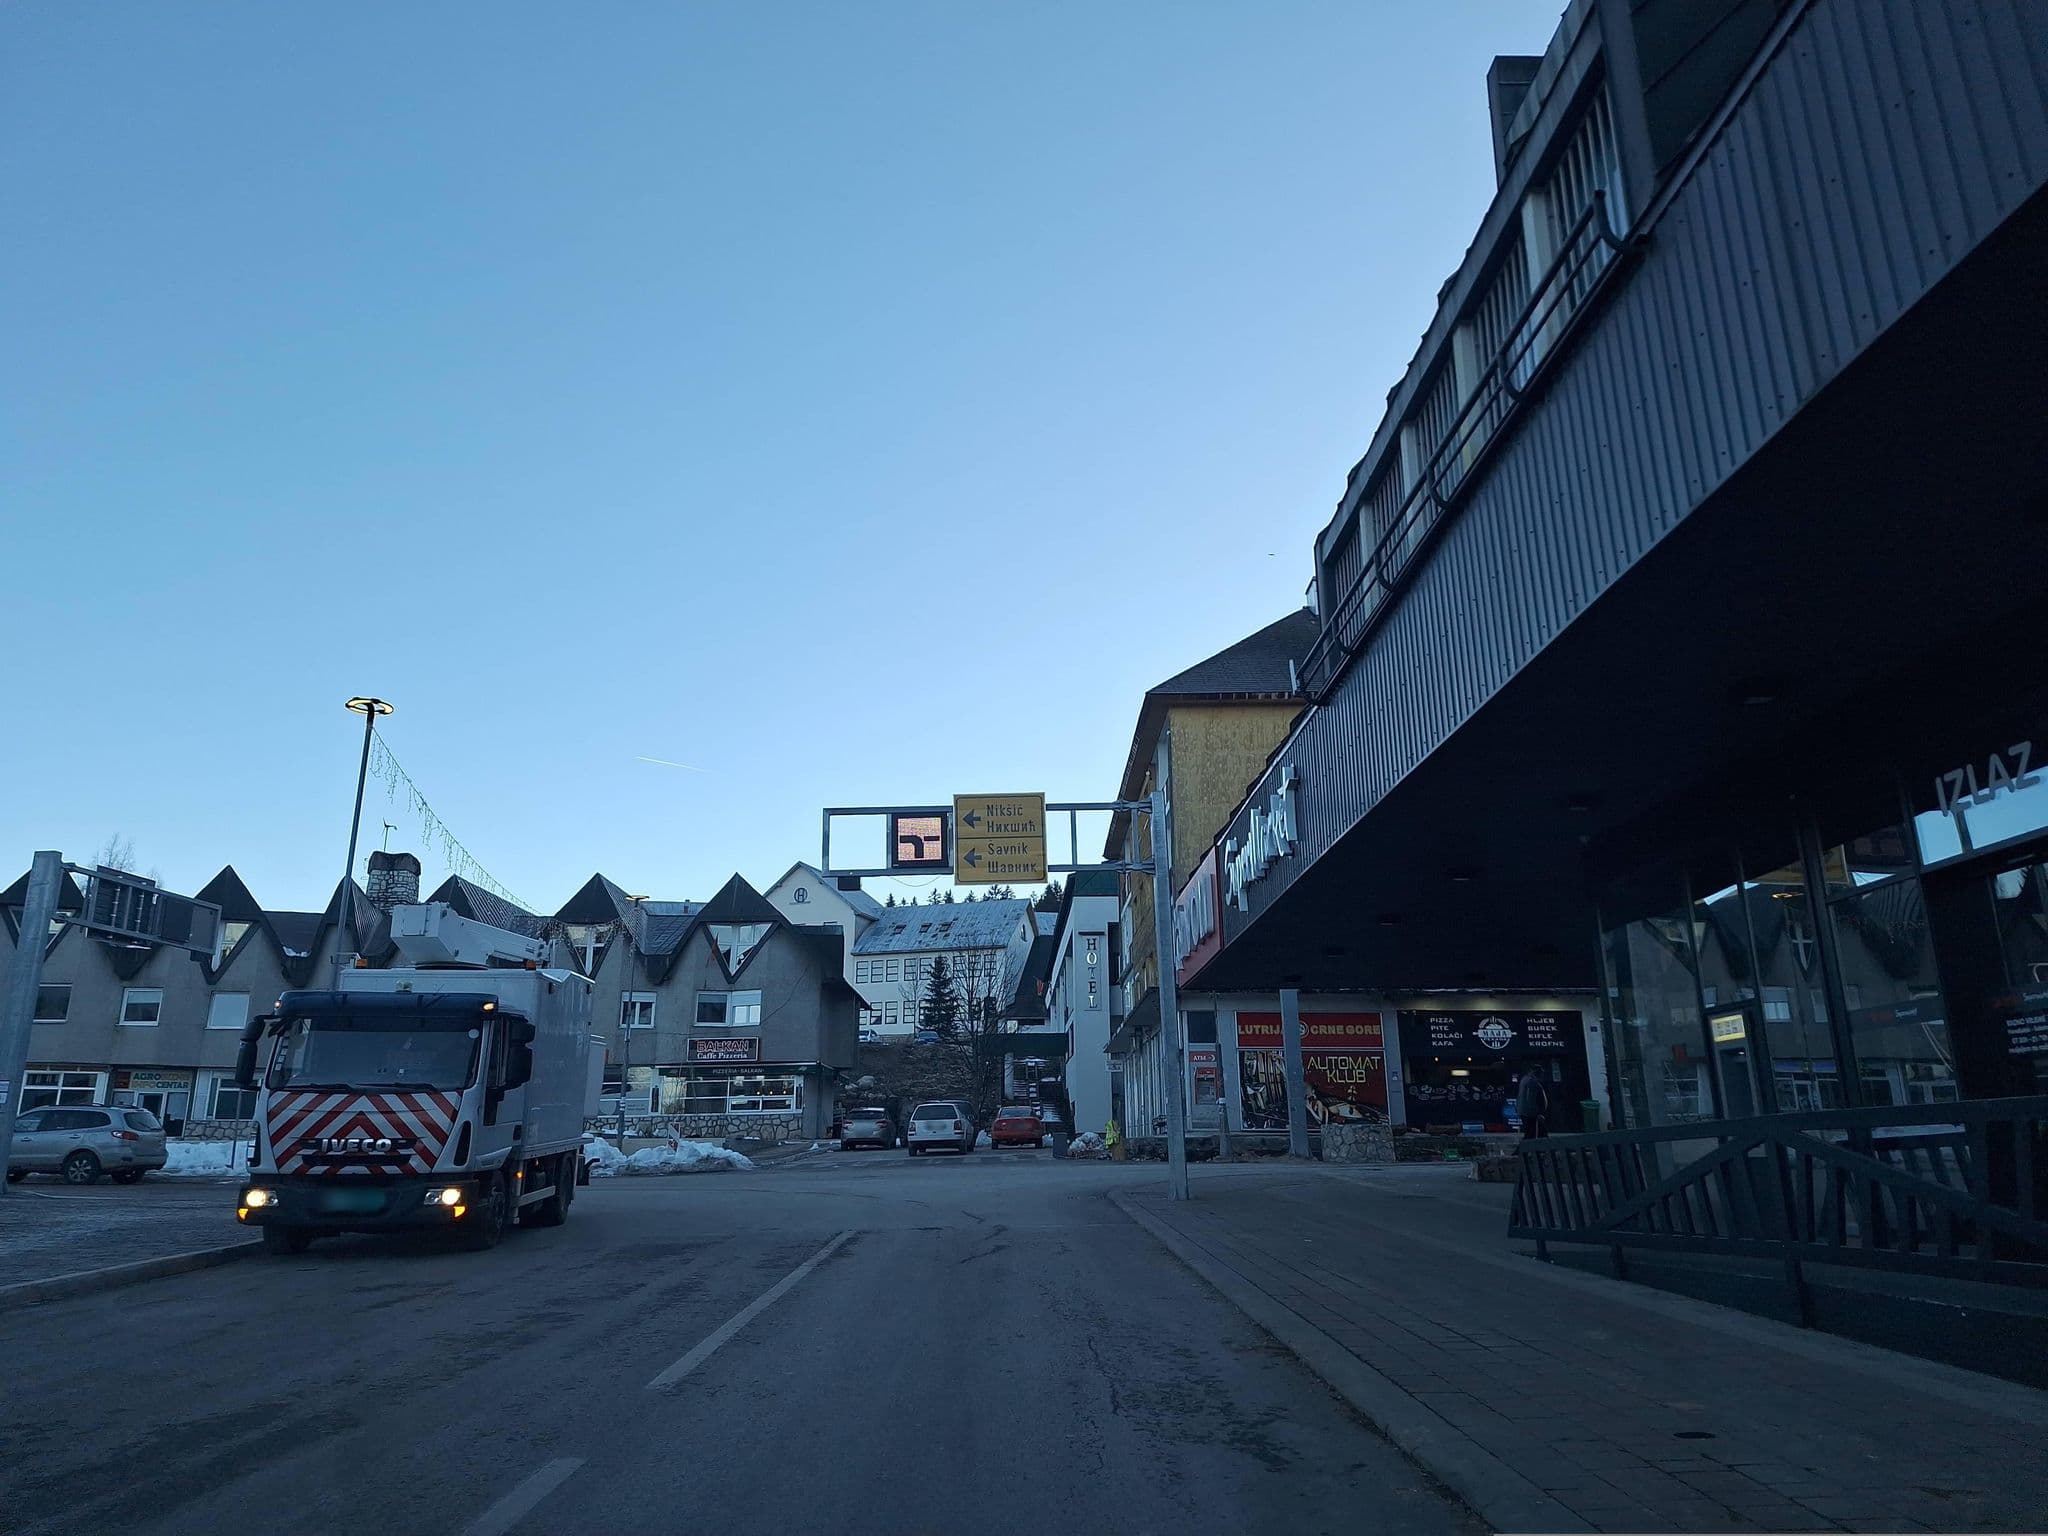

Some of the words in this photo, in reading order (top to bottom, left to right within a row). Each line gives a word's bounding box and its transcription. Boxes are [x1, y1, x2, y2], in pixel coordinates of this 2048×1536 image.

[1935, 740, 2041, 817] IZLAZ
[987, 819, 1036, 833] Никшић
[987, 840, 1028, 855] Šavnik
[988, 861, 1037, 873] Шавник
[1086, 938, 1097, 1008] HOTEL
[1310, 1024, 1344, 1035] CRNE
[1345, 1024, 1381, 1035] GORE
[697, 1040, 749, 1052] BALKAN
[718, 1051, 748, 1059] Pizzeria
[1307, 1056, 1381, 1070] AUTOMAT
[1327, 1069, 1367, 1083] KLUB
[321, 1138, 392, 1152] IVECO
